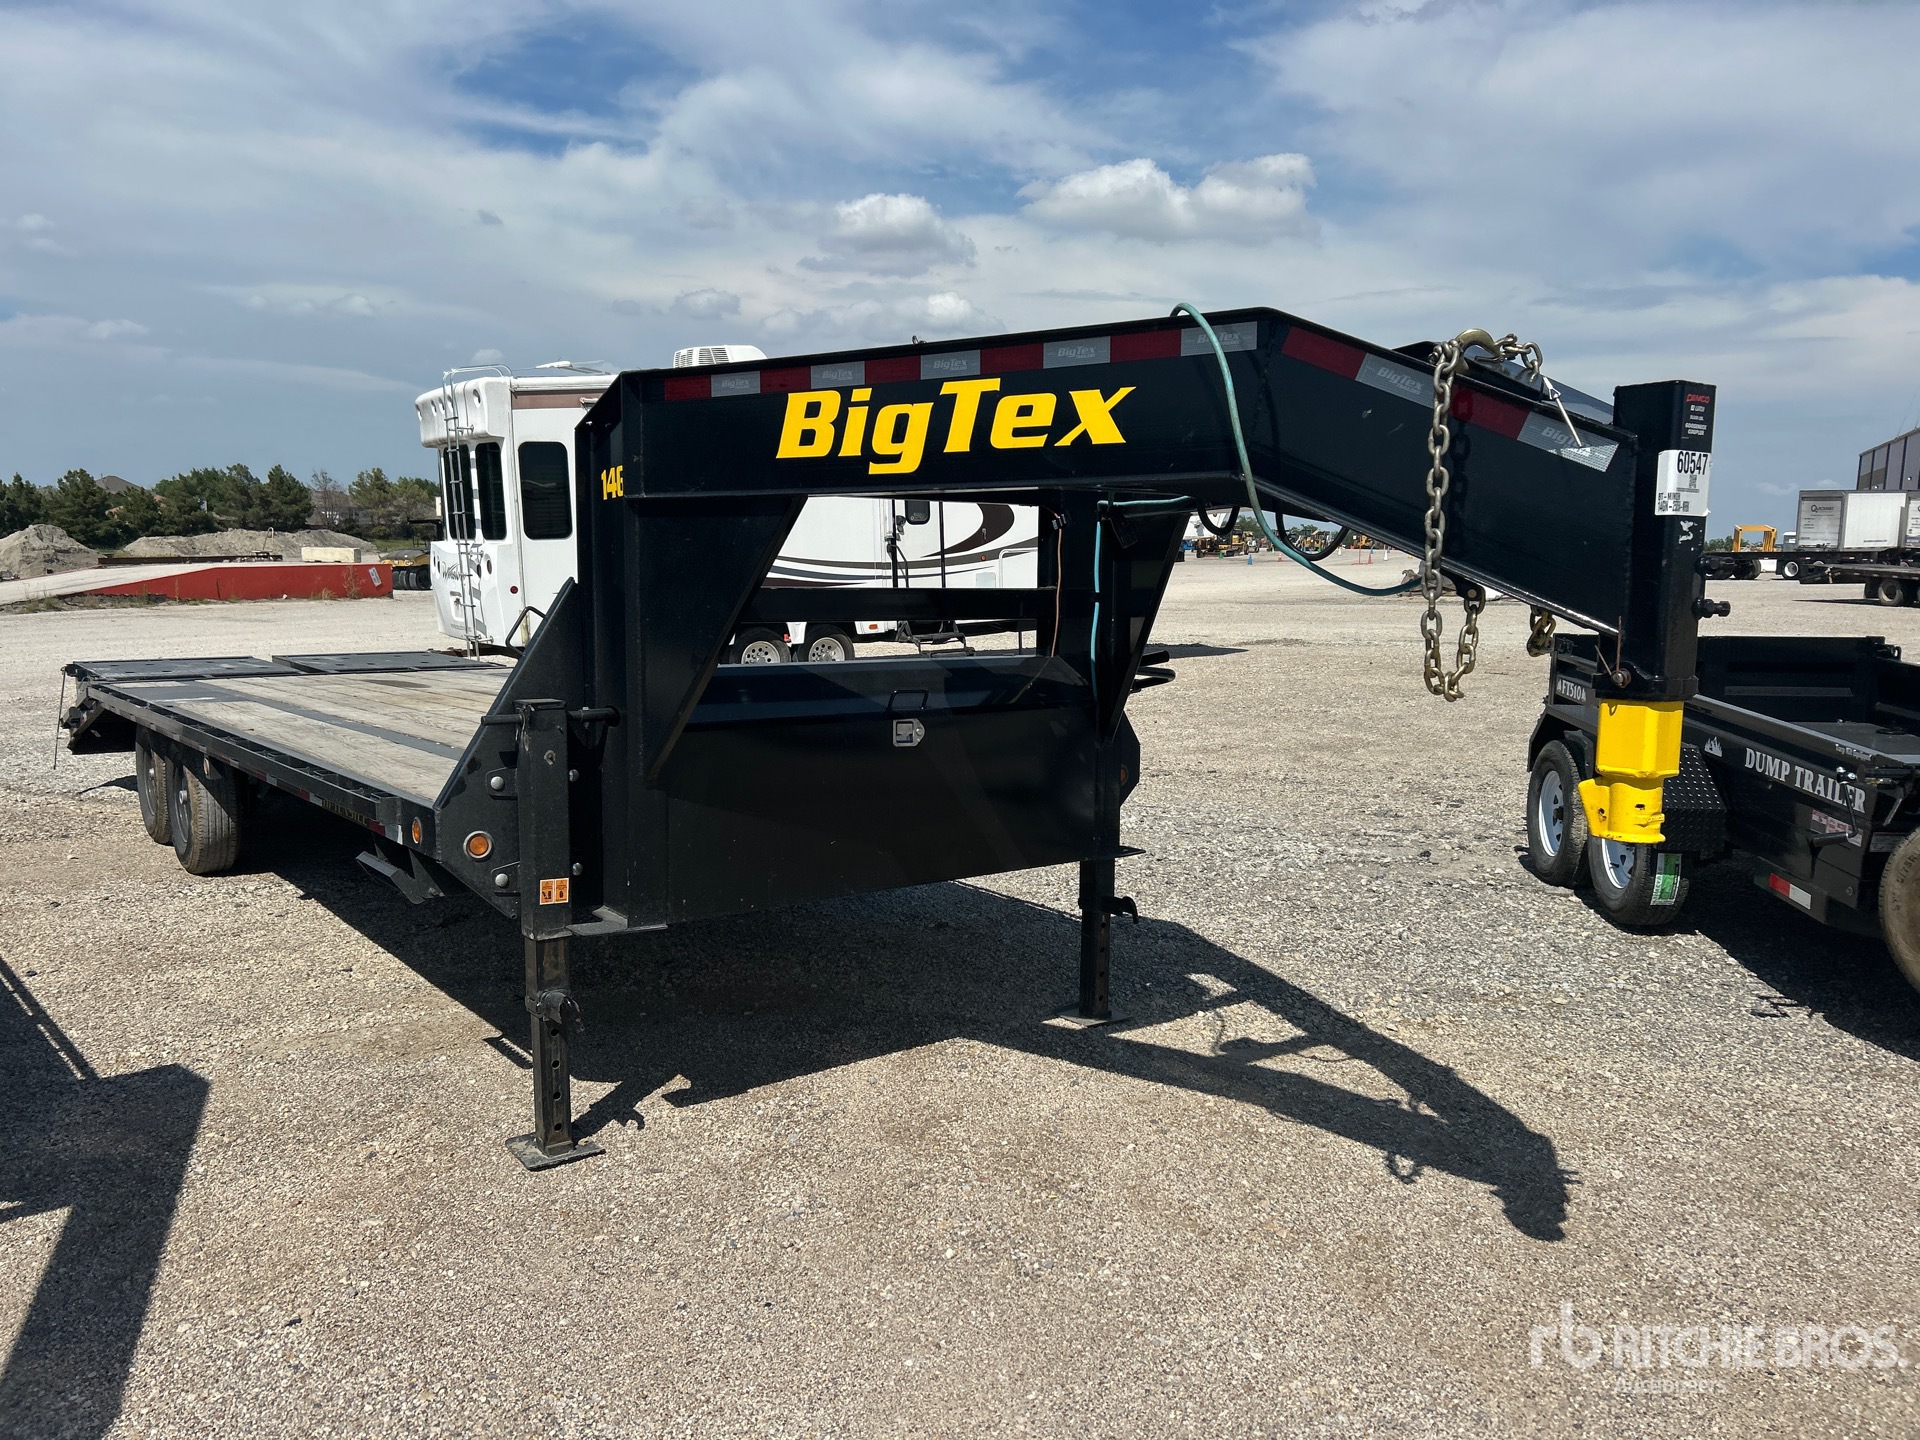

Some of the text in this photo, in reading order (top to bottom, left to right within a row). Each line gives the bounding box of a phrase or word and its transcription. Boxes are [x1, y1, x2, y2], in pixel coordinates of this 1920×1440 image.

[933, 358, 968, 370] BigTex
[1057, 345, 1097, 358] BigTex
[1377, 366, 1424, 391] BigTex
[776, 377, 1137, 475] BigTex
[1677, 450, 1709, 475] 60547
[1561, 679, 1582, 701] FT510
[1744, 747, 1791, 782] DUMP
